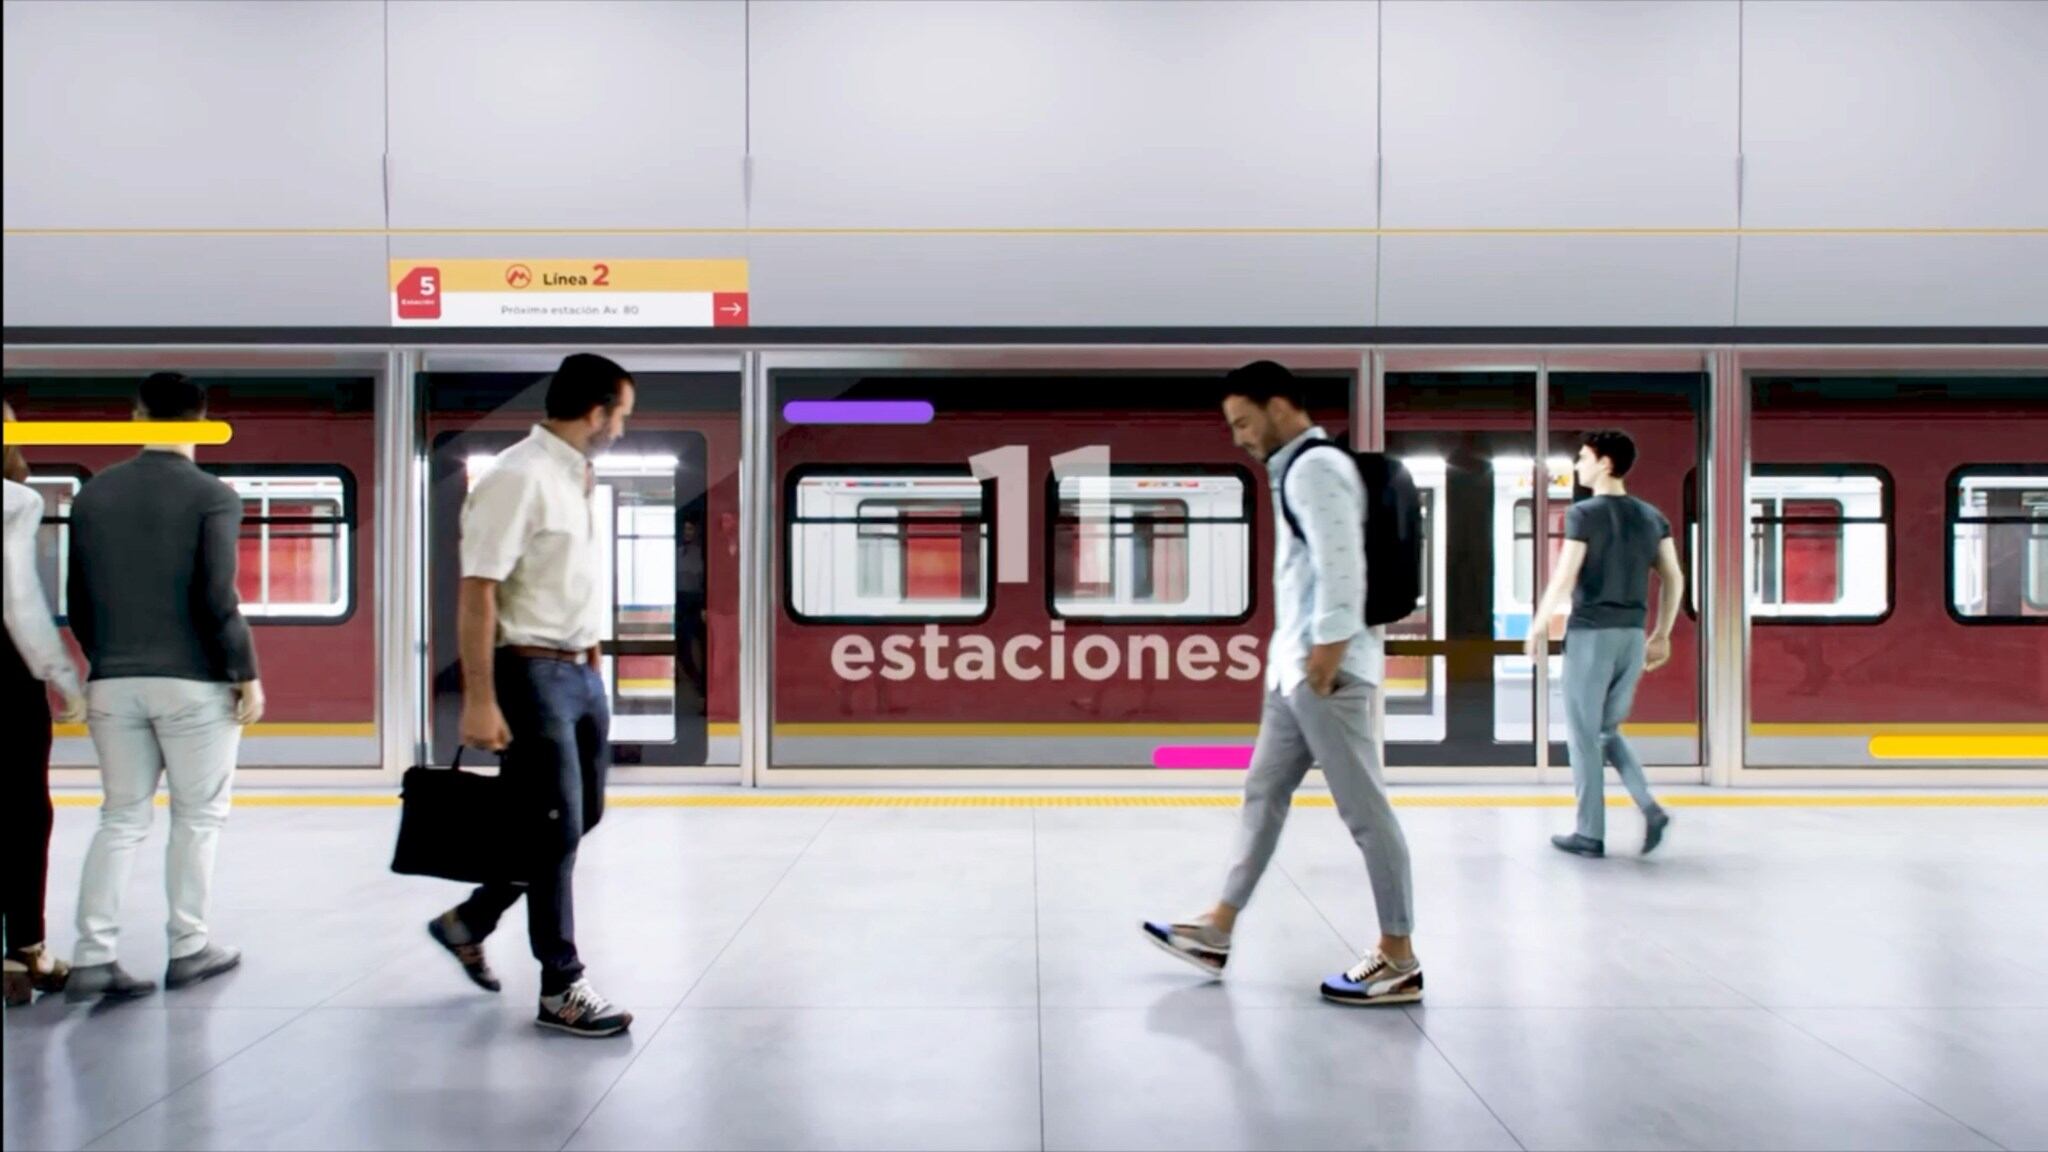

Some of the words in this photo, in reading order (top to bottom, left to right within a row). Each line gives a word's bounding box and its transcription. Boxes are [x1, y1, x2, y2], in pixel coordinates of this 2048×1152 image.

[543, 270, 588, 286] Línea
[592, 264, 609, 286] 2
[420, 276, 435, 296] 5
[551, 304, 600, 315] estación
